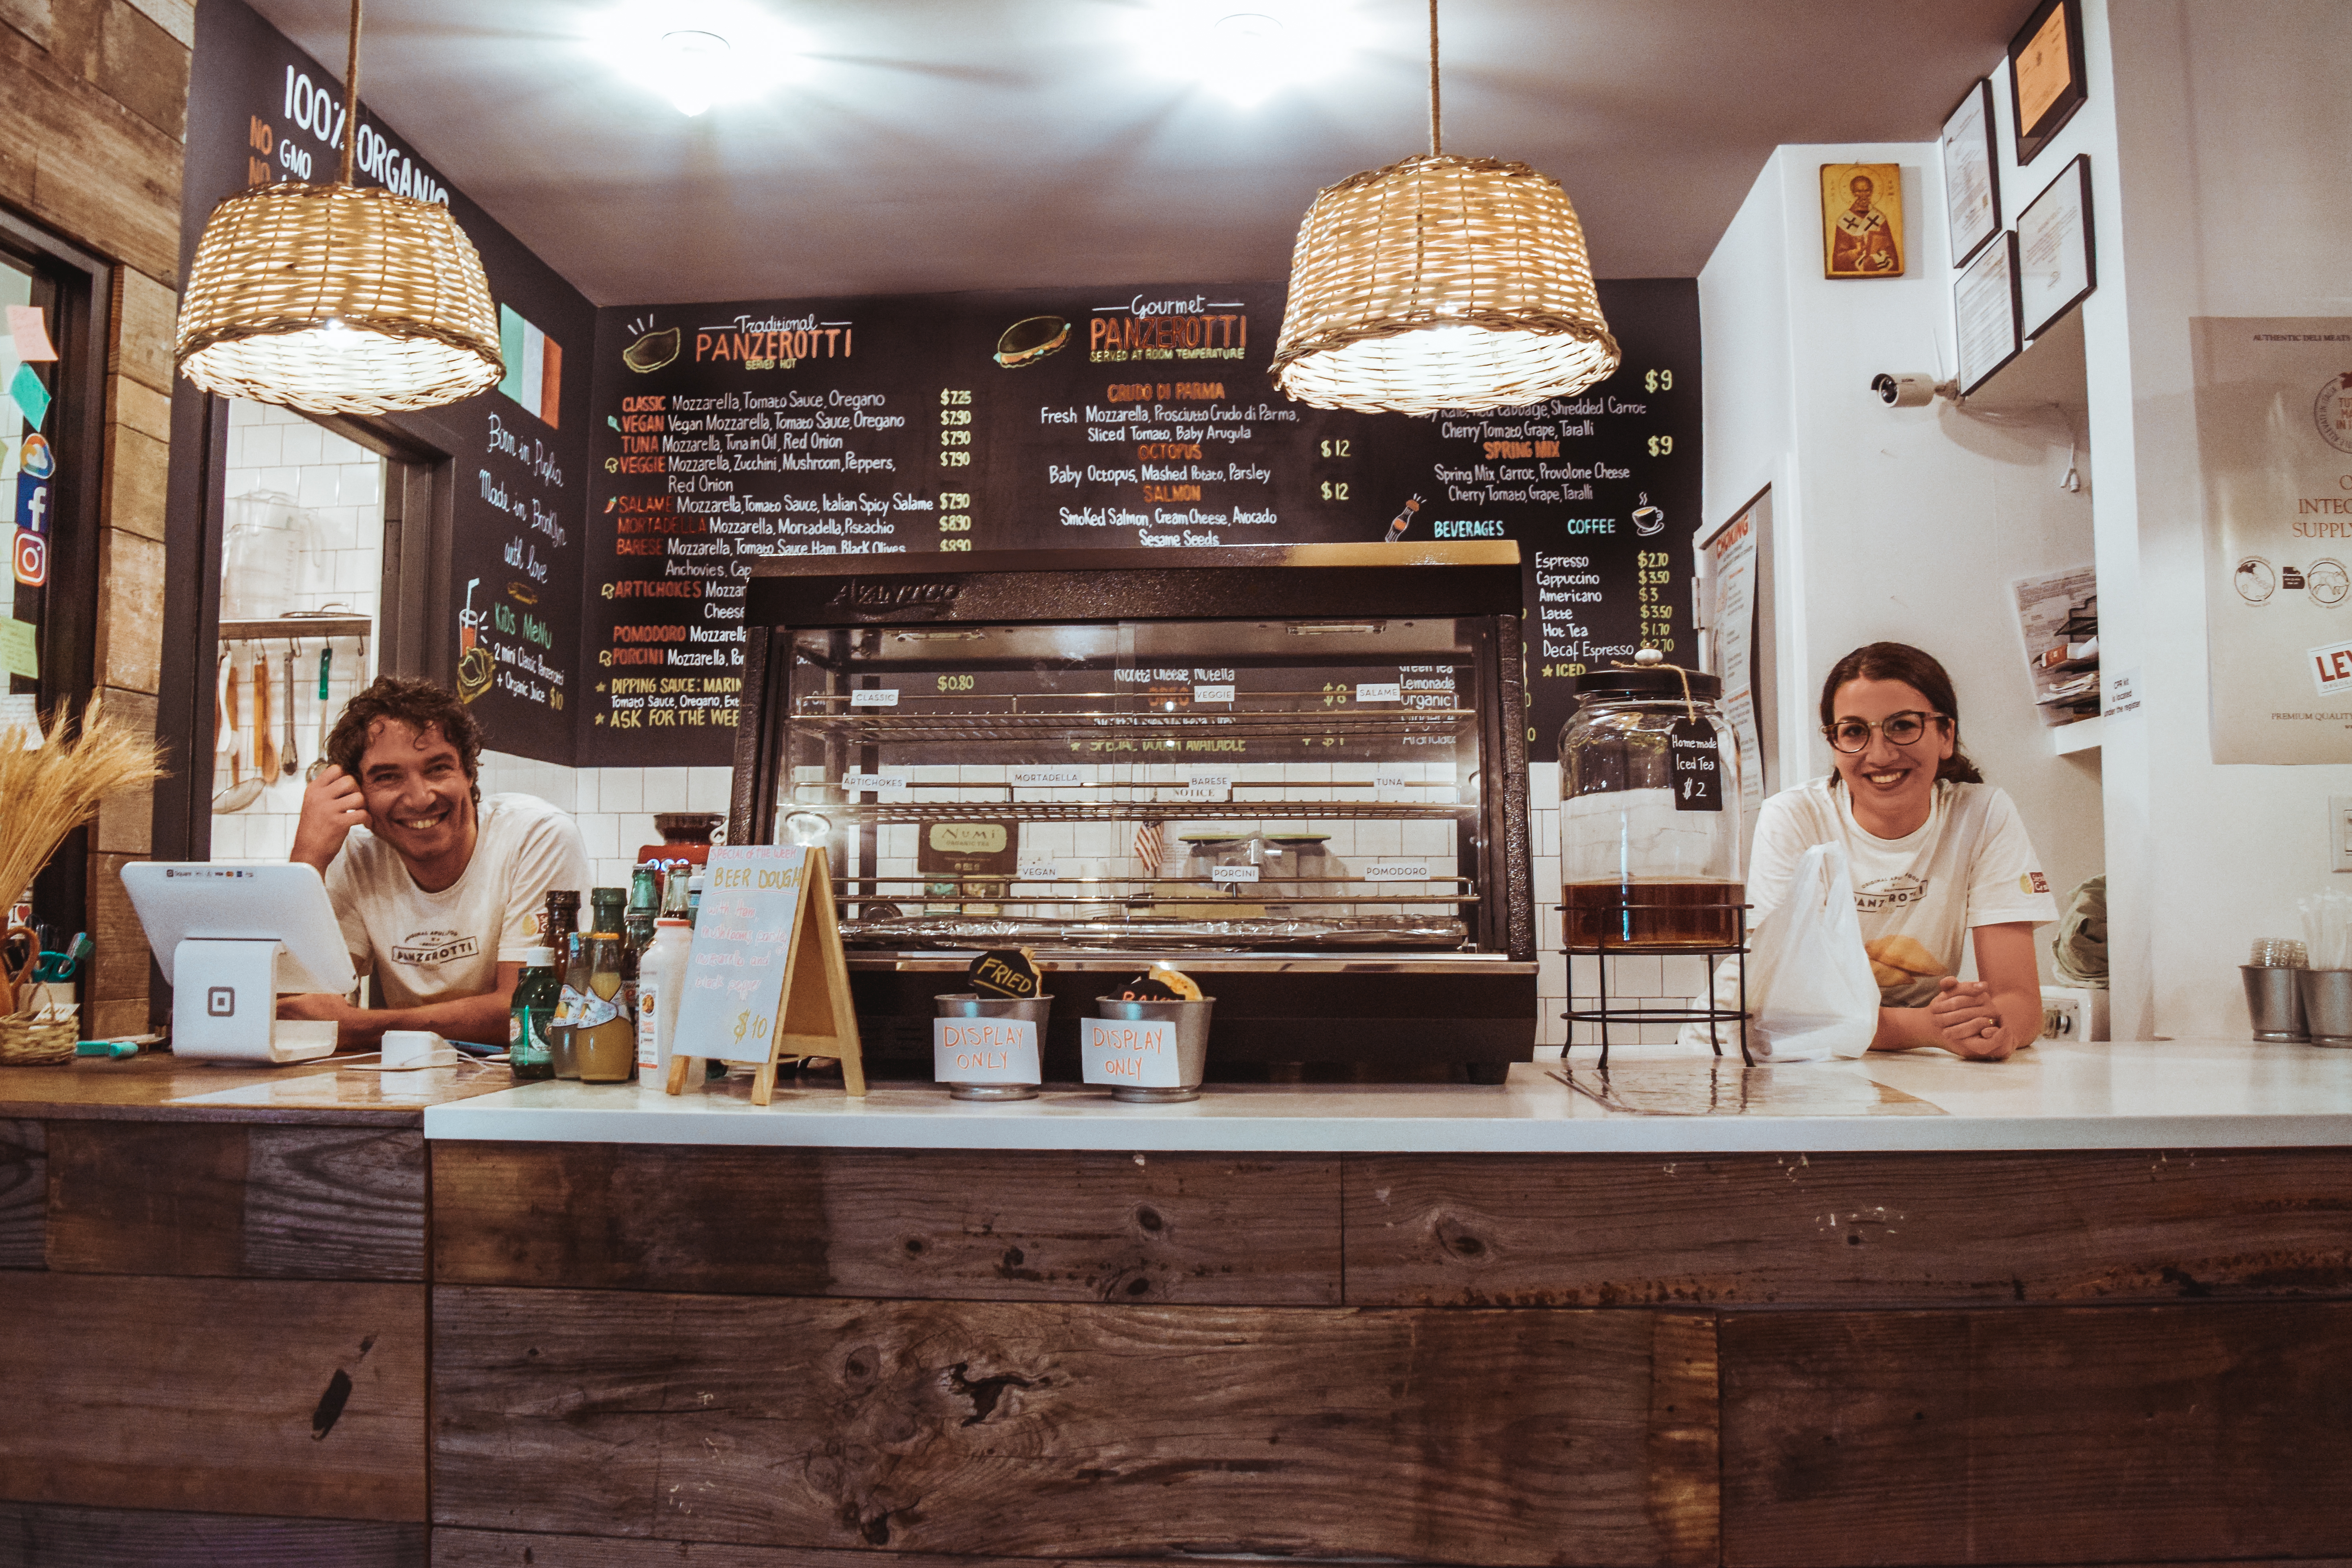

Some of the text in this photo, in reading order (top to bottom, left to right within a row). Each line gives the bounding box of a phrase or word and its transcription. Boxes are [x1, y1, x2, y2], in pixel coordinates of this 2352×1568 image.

[283, 63, 347, 153] 100%
[250, 116, 311, 181] NO GMO
[1131, 295, 1207, 321] Gourmet
[733, 314, 819, 334] Traditional
[1091, 314, 1246, 352] PANZEROTTI
[696, 327, 851, 363] PANZEROTTI
[1090, 346, 1245, 362] SERVED AT ROOM TEMPERATURE
[744, 357, 797, 370] SERVED HOT
[1645, 369, 1672, 393] $9
[623, 390, 885, 412] CLASSIC Mozzarella, Tomato Sauce, Oregano
[1157, 383, 1170, 401] DI
[1176, 382, 1225, 399] PARMA
[1042, 404, 1299, 423] Fresh Mozzarella, Prosciutto Crudo di Parma,
[1549, 397, 1603, 415] Shredded
[1608, 396, 1646, 414] Carrot
[1138, 442, 1202, 460] OCTOPUS
[1321, 440, 1350, 457] $12
[1535, 439, 1560, 458] MIX
[1648, 436, 1672, 457] $9
[1050, 463, 1270, 488] Baby Octopus, Mashed Potato, Parsley
[479, 469, 509, 512] Made
[1144, 484, 1200, 502] SALMON
[1321, 481, 1349, 500] $12
[619, 492, 933, 517] SALAME Mozzarella, Tomato Sauce, Italian Spicy Salame
[1108, 508, 1152, 528] Salmon,
[1155, 508, 1190, 525] Cream
[1189, 508, 1231, 526] Cheese,
[1233, 506, 1277, 524] Avocado
[1568, 519, 1615, 534] COFFEE
[1139, 529, 1221, 547] Sesame Seeds
[1434, 521, 1504, 537] BEVERAGES
[1536, 552, 1589, 570] Espresso
[614, 581, 701, 598] ARTICHOKES
[1536, 571, 1599, 589] Cappuccino
[1540, 587, 1602, 602] Americano
[1639, 587, 1658, 602] $3
[1541, 606, 1573, 620] Latte
[613, 625, 686, 642] POMODORO
[1543, 623, 1588, 637] Hot Tea
[1544, 640, 1635, 664] Decaf Espresso
[1556, 664, 1586, 676] ICED
[612, 678, 700, 694] DIPPING SAUCE:
[1399, 672, 1455, 691] Lemonade
[610, 708, 705, 728] ASK FOR THE
[1672, 733, 1718, 748] Homemade
[1677, 754, 1714, 770] Iced Tea
[844, 777, 902, 788] ARTICHOKES
[1173, 787, 1212, 796] NOTICE
[710, 847, 743, 861] SPECIAL
[756, 847, 771, 859] THE
[714, 866, 803, 889] BEER DOUGH
[750, 950, 771, 966] and
[975, 956, 1034, 994] FRIED
[944, 1026, 1023, 1049] DISPLAY
[1093, 1027, 1163, 1054] DISPLAY
[956, 1051, 1008, 1070] ONLY
[1105, 1057, 1142, 1081] ONLY
